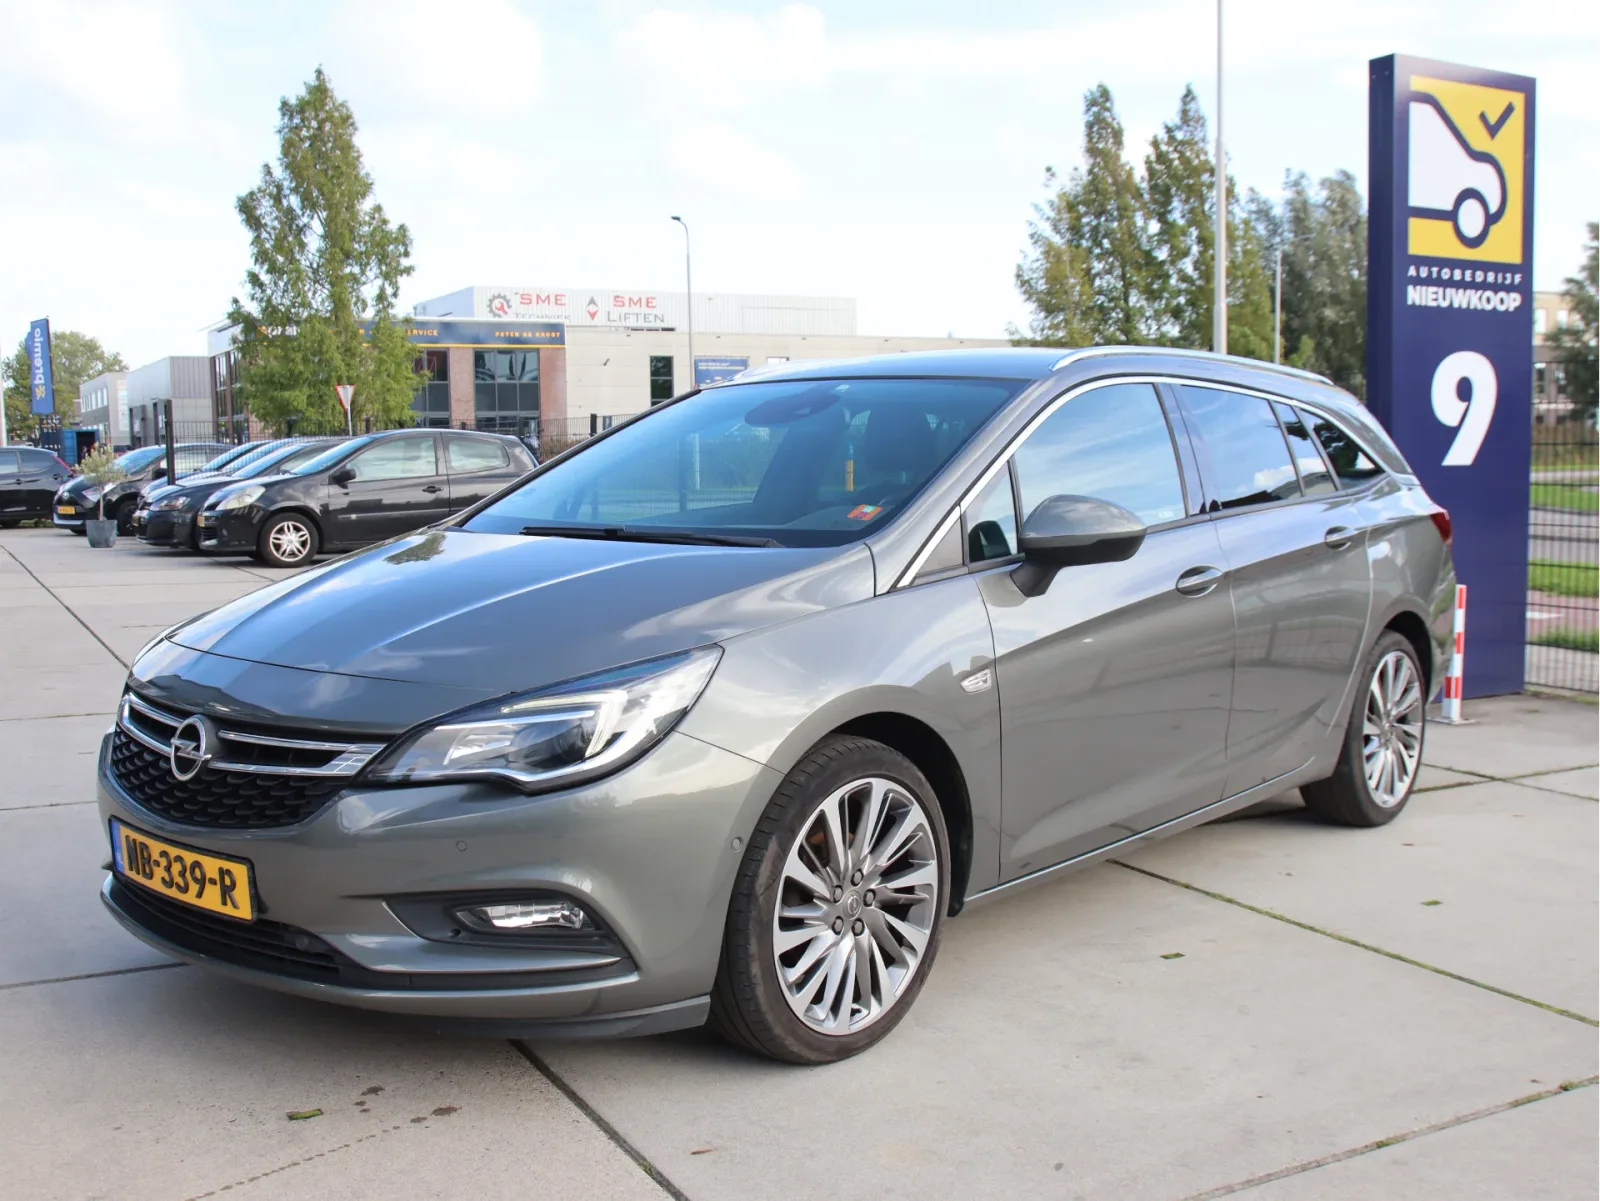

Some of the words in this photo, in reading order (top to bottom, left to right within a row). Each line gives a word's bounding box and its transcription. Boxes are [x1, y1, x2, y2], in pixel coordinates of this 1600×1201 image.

[1406, 265, 1523, 285] AUTOBEDRIJF
[519, 293, 567, 306] SME
[612, 295, 657, 309] SME
[1406, 284, 1522, 312] NIEUWKOOP
[607, 310, 665, 323] LIFTEN
[34, 328, 45, 385] premio
[1430, 350, 1498, 467] 9
[124, 834, 240, 910] NB-339-R
